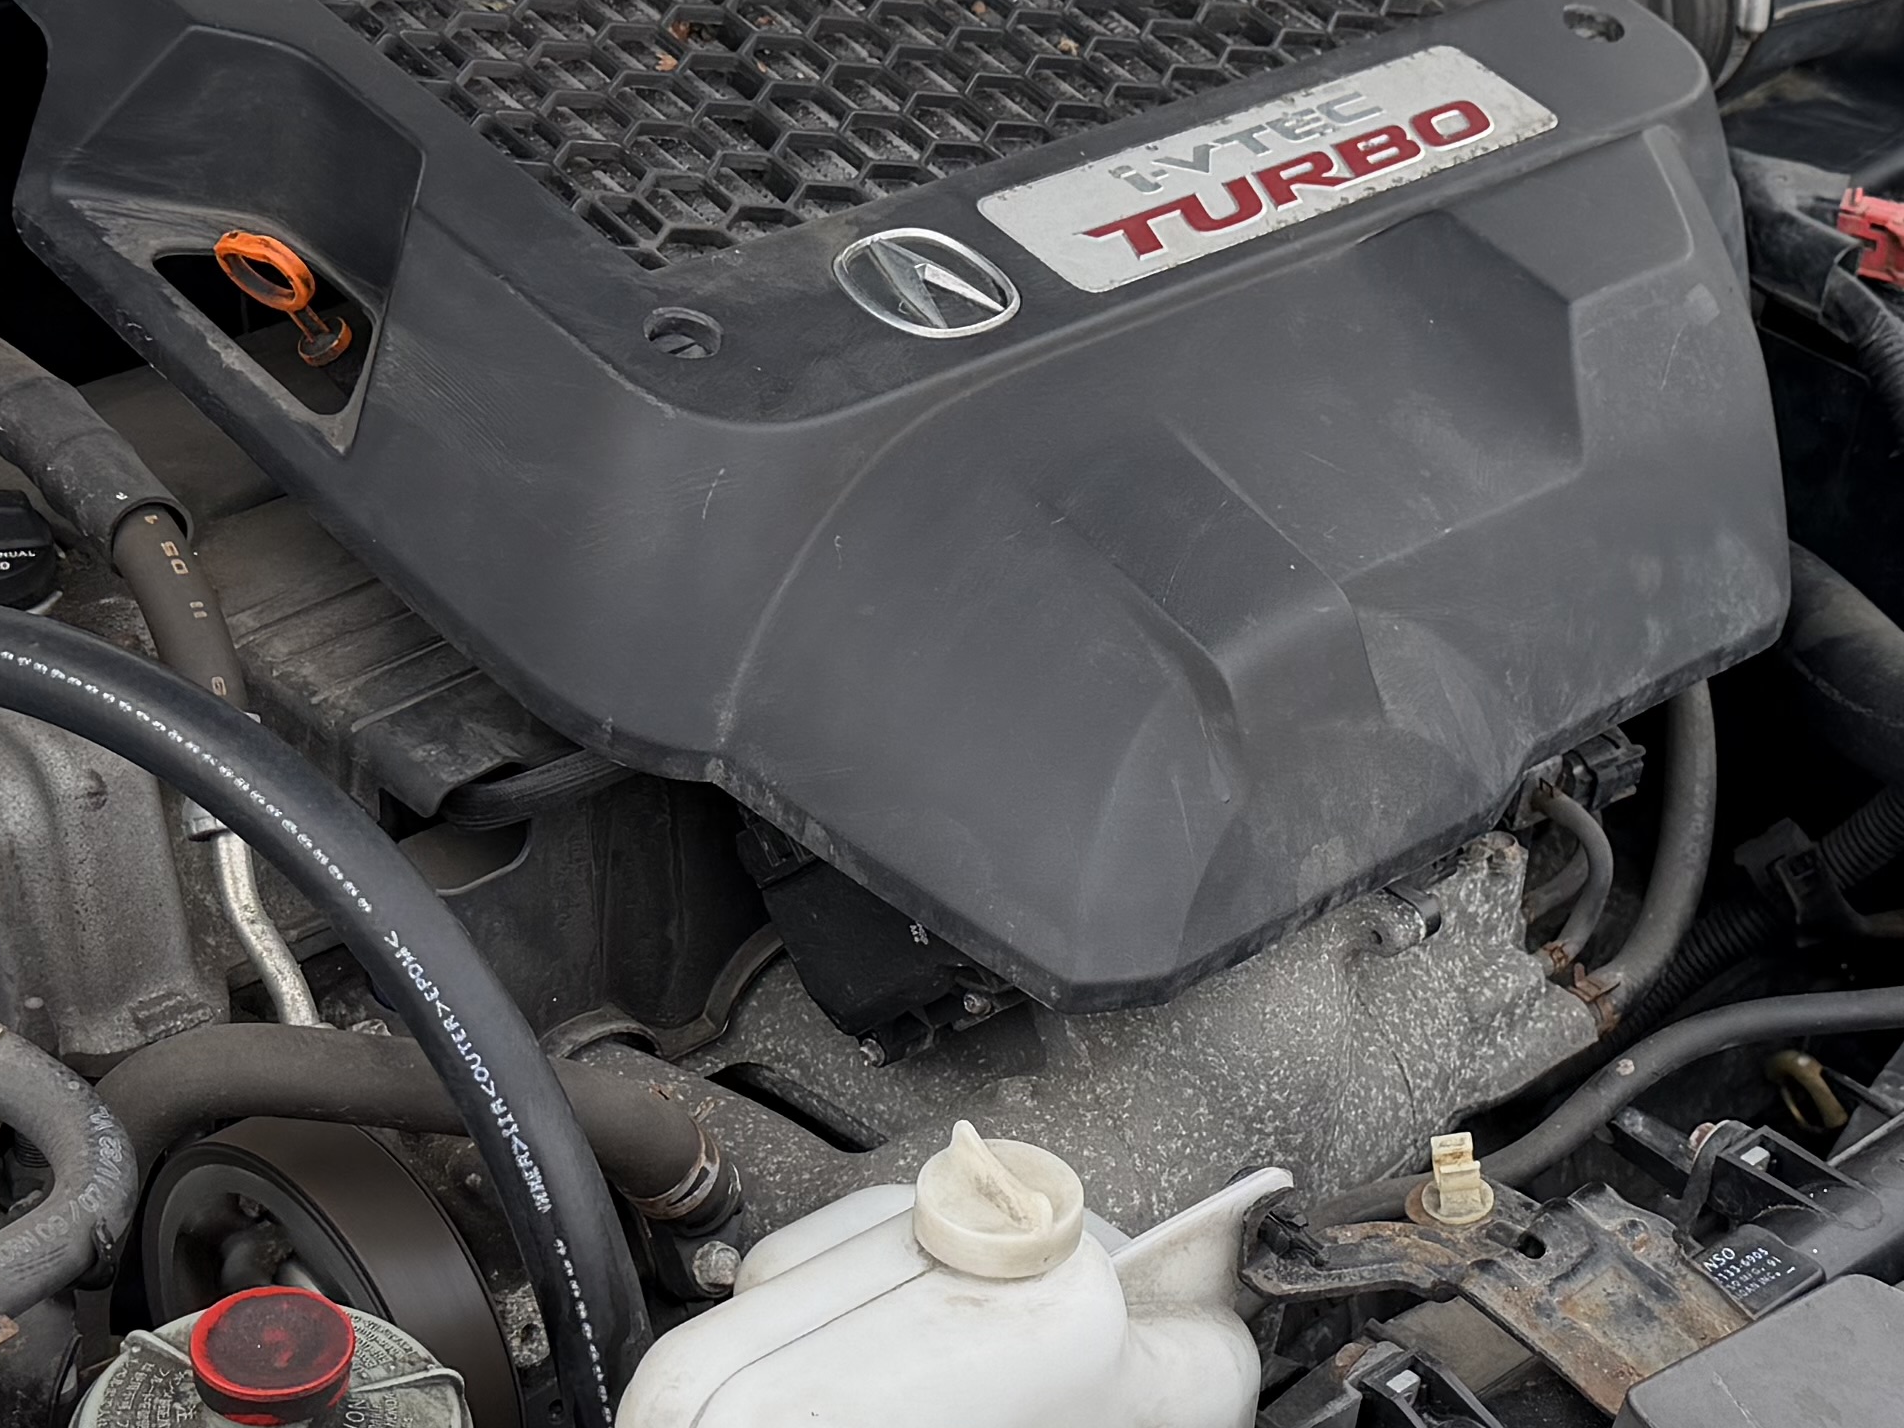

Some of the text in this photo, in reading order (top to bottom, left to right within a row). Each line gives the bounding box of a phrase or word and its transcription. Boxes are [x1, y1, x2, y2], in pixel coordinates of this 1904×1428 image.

[1074, 100, 1493, 262] TURBO
[1112, 86, 1383, 194] i-VTEC
[1703, 1247, 1736, 1272] NSO
